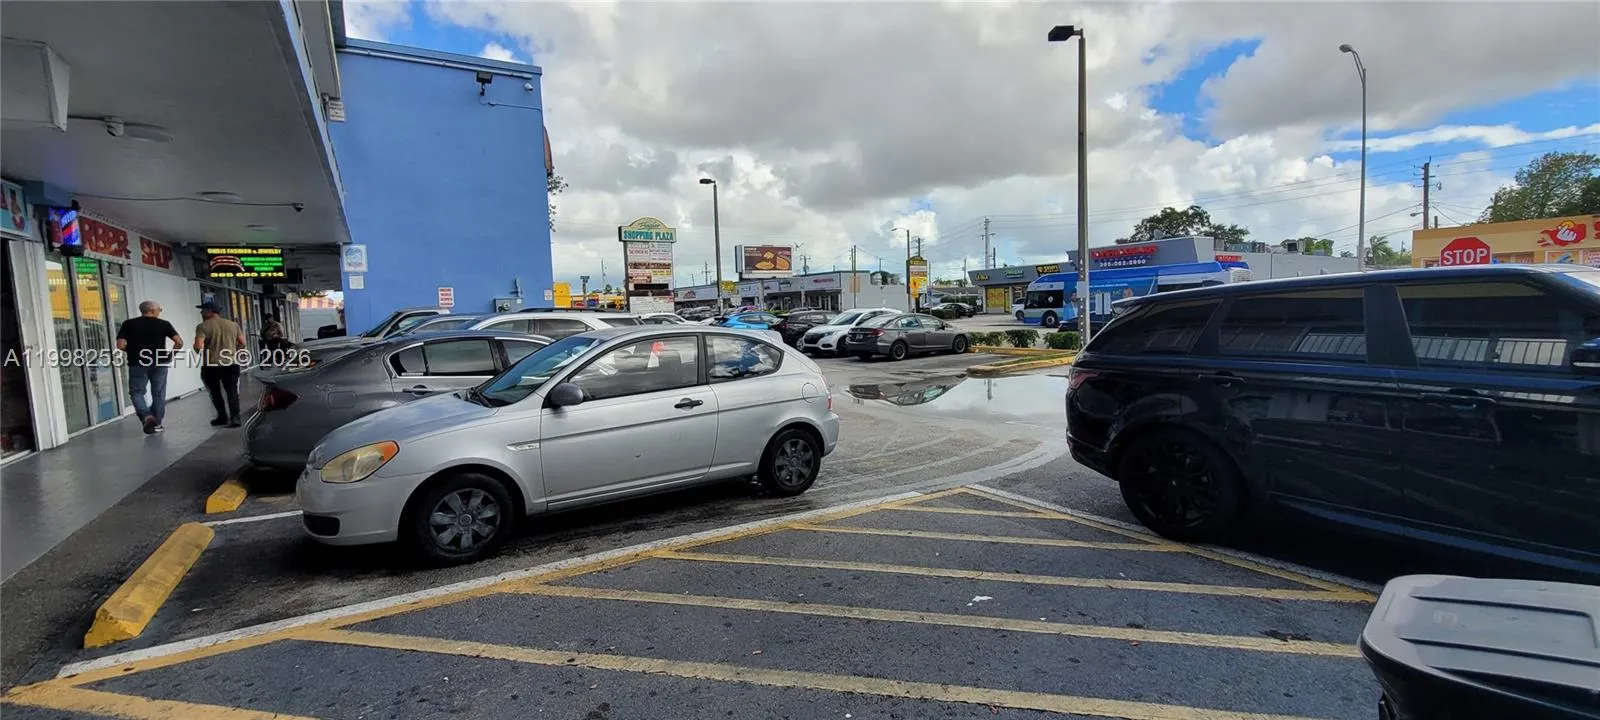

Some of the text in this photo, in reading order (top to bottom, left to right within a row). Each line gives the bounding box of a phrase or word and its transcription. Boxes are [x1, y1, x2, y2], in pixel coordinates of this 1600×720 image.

[623, 230, 674, 241] SHOPPING PLAZA
[139, 236, 173, 269] SHOP
[1443, 248, 1488, 265] STOP
